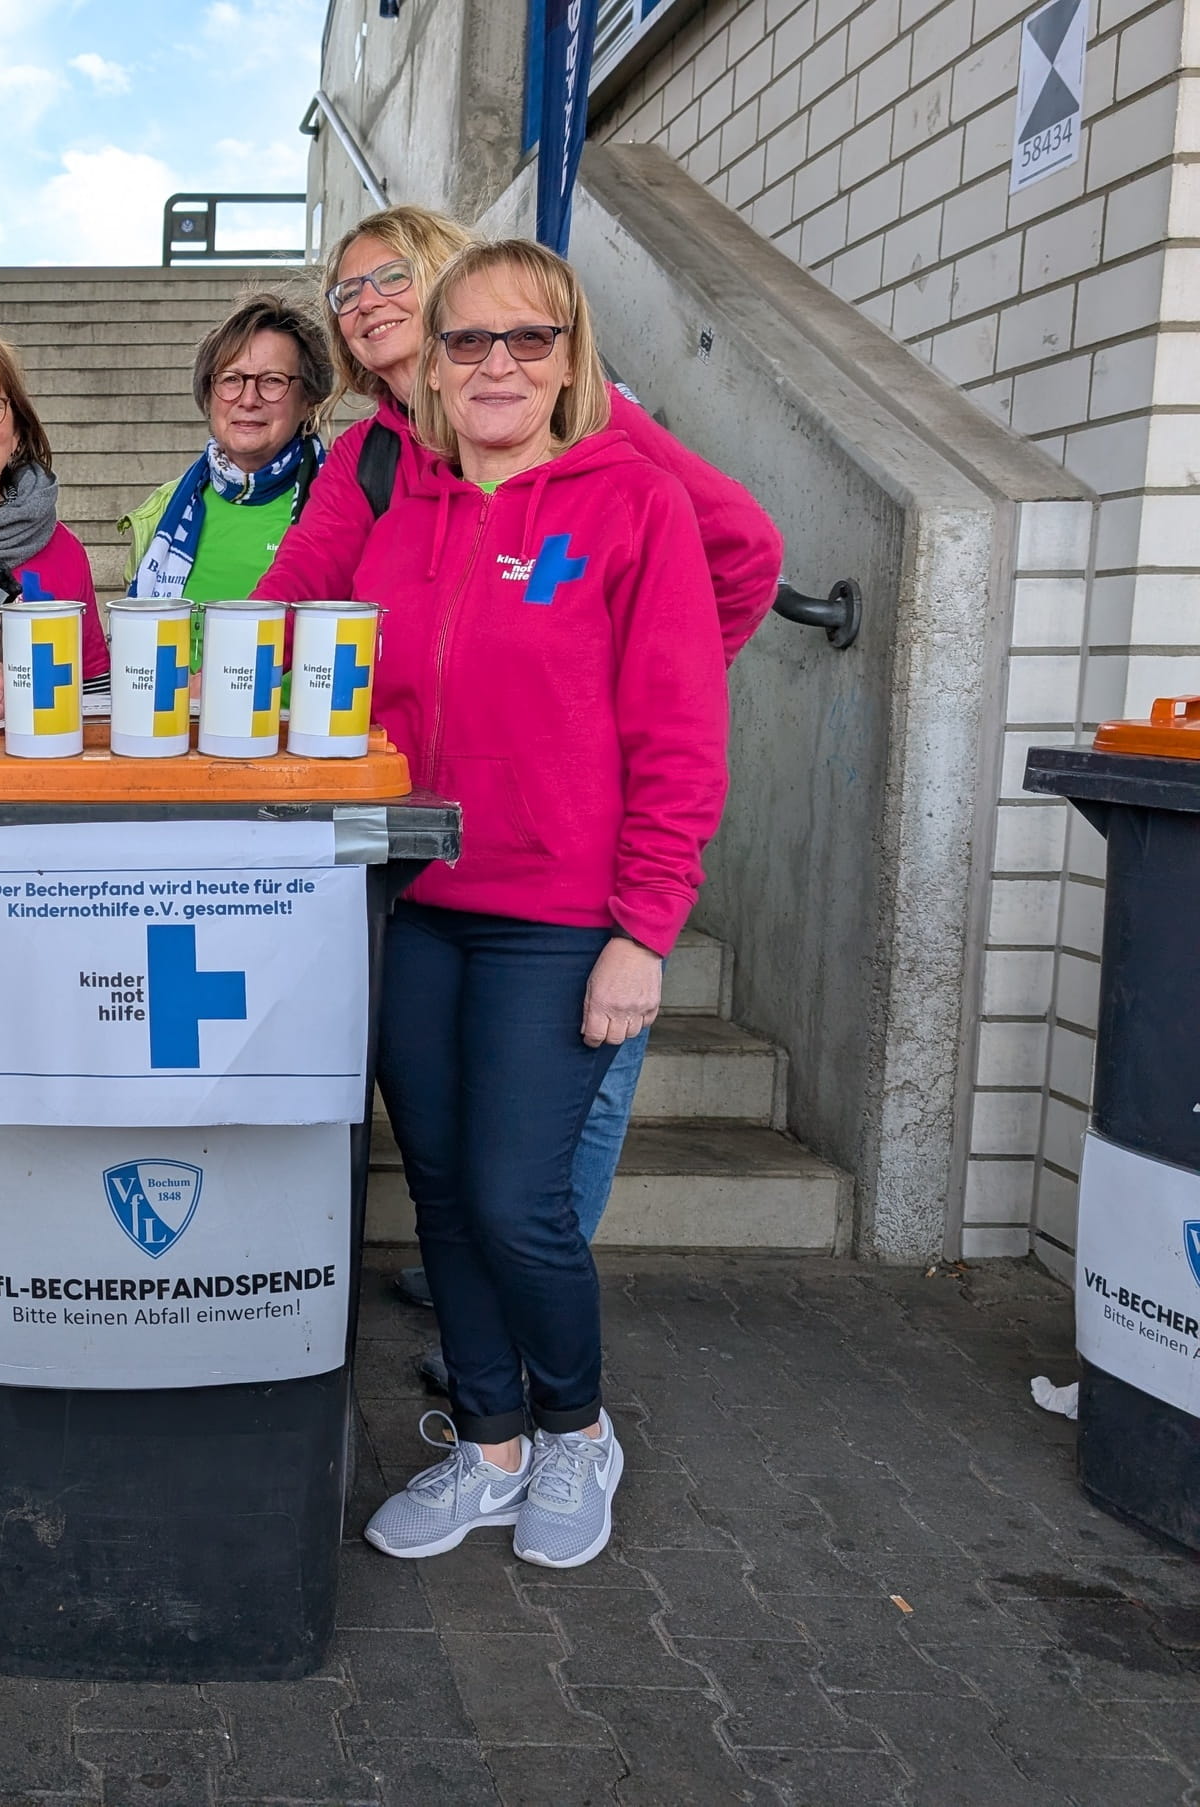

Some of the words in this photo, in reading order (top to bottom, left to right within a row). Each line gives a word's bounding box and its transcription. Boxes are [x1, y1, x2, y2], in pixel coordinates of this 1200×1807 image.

[1021, 118, 1072, 167] 58434
[496, 554, 536, 566] kinr
[146, 558, 186, 585] Bchum
[502, 570, 530, 580] hilfe
[7, 664, 31, 672] kinder
[125, 666, 154, 675] kinder
[223, 666, 254, 675] kinder
[303, 664, 332, 673] kinder
[17, 672, 31, 680] not
[237, 674, 253, 682] not
[315, 673, 331, 681] not
[13, 680, 32, 688] hilfe
[132, 682, 153, 691] hilfe
[230, 682, 253, 690] hilfe
[309, 681, 331, 689] hilfe
[25, 881, 145, 899] Becherpfand
[149, 880, 192, 895] wird
[196, 880, 250, 894] heute
[253, 879, 282, 894] für
[286, 878, 315, 893] die
[7, 902, 140, 917] Kindernothilfe
[143, 901, 179, 916] e.V.
[182, 900, 292, 919] gesammelt!
[80, 971, 145, 987] kinder
[111, 988, 144, 1003] not
[98, 1005, 145, 1021] hilfe
[147, 1178, 190, 1188] Bochum
[158, 1191, 181, 1201] 1848
[110, 1177, 167, 1243] VfL
[1084, 1266, 1199, 1339] VfL-BECHER
[13, 1306, 57, 1324] Bitte
[63, 1308, 128, 1325] keinen
[134, 1307, 189, 1325] Abfall
[197, 1298, 301, 1323] einwerfen!
[1103, 1304, 1135, 1331] Bitte
[1139, 1321, 1188, 1356] keinen
